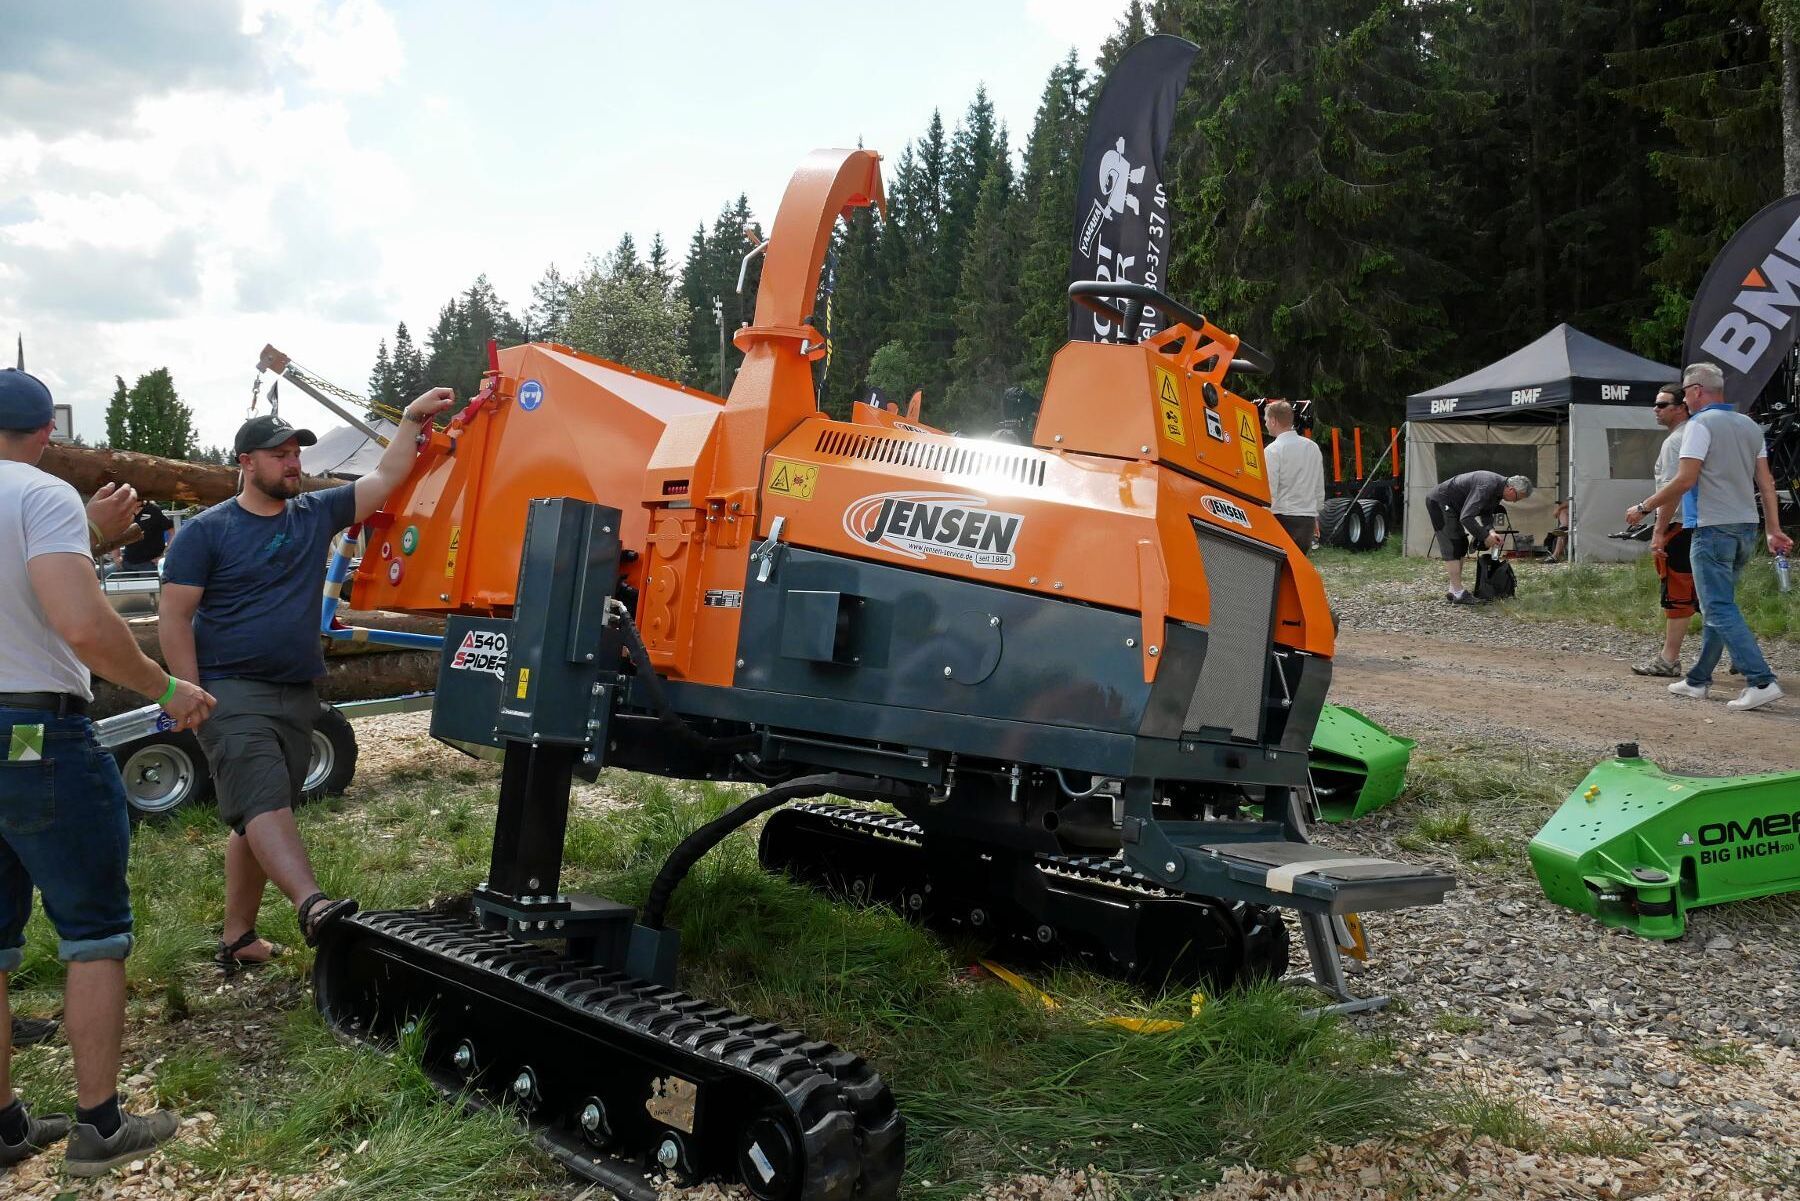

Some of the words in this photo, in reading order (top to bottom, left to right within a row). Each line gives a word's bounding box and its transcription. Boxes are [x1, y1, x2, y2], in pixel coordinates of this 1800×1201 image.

[1082, 208, 1102, 251] YAMAHA
[1149, 212, 1165, 238] 37
[1511, 387, 1542, 405] BMF
[1601, 385, 1630, 400] BMF
[1430, 398, 1458, 414] BMF
[1209, 499, 1247, 522] JENSEN
[865, 498, 1019, 553] JENSEN
[908, 543, 973, 561] www.jensen-service.de
[978, 555, 990, 563] seit
[463, 633, 506, 652] A540
[1701, 848, 1731, 865] BIG
[1736, 840, 1780, 860] INCH
